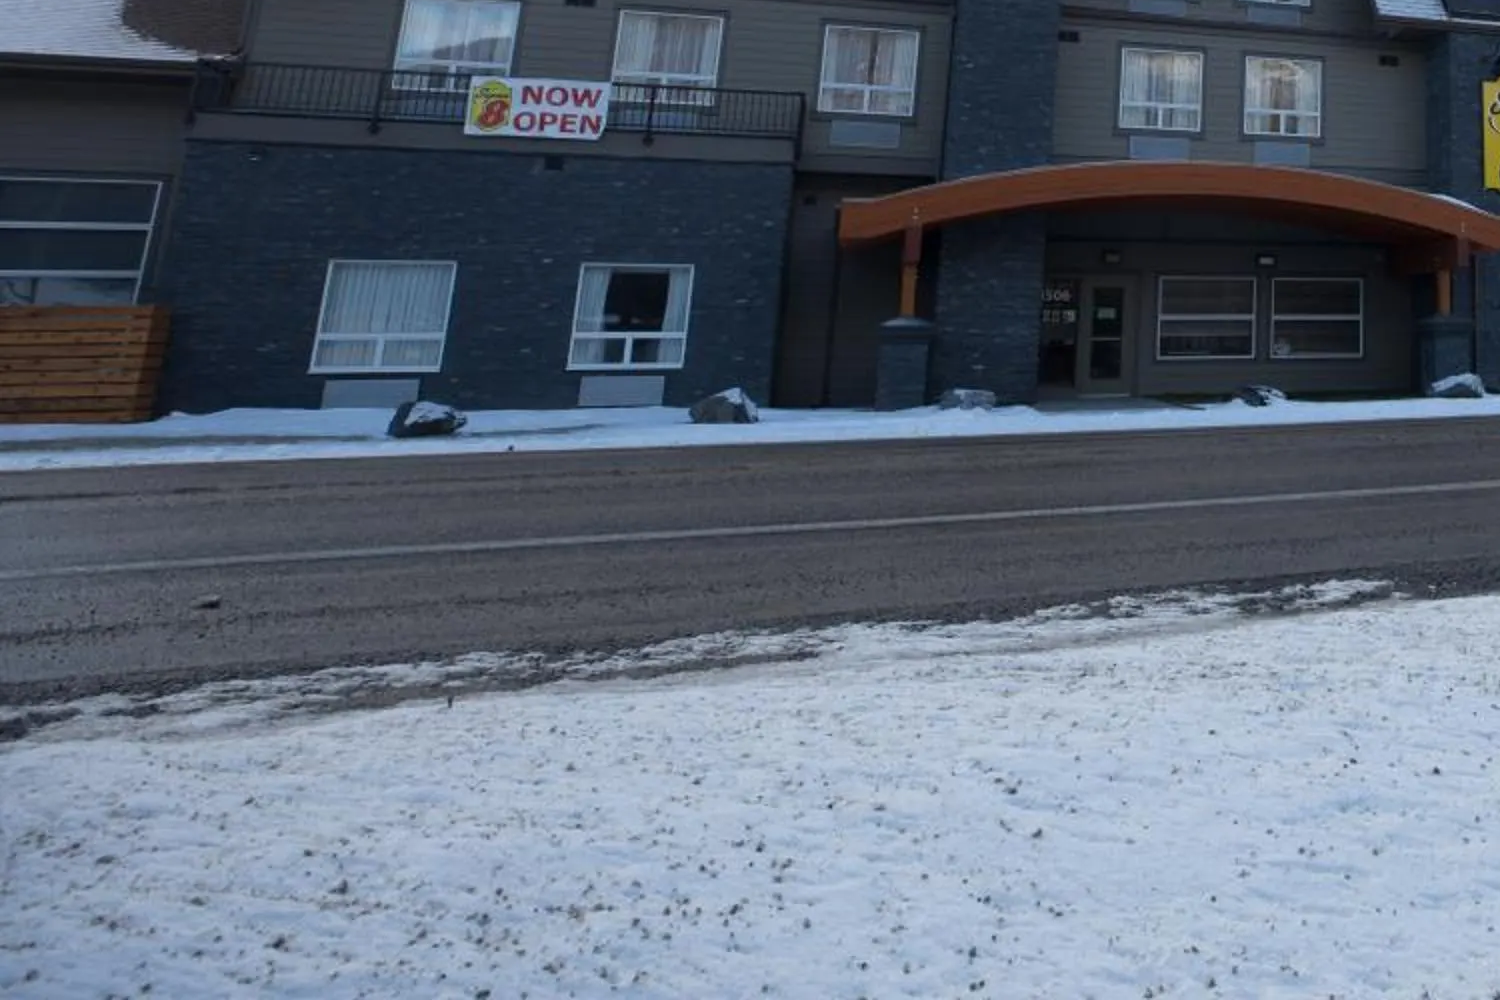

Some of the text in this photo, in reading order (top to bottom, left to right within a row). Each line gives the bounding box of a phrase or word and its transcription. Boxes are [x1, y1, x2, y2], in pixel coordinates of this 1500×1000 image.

[521, 85, 602, 109] NOW
[478, 99, 509, 128] 8
[513, 111, 602, 134] OPEN
